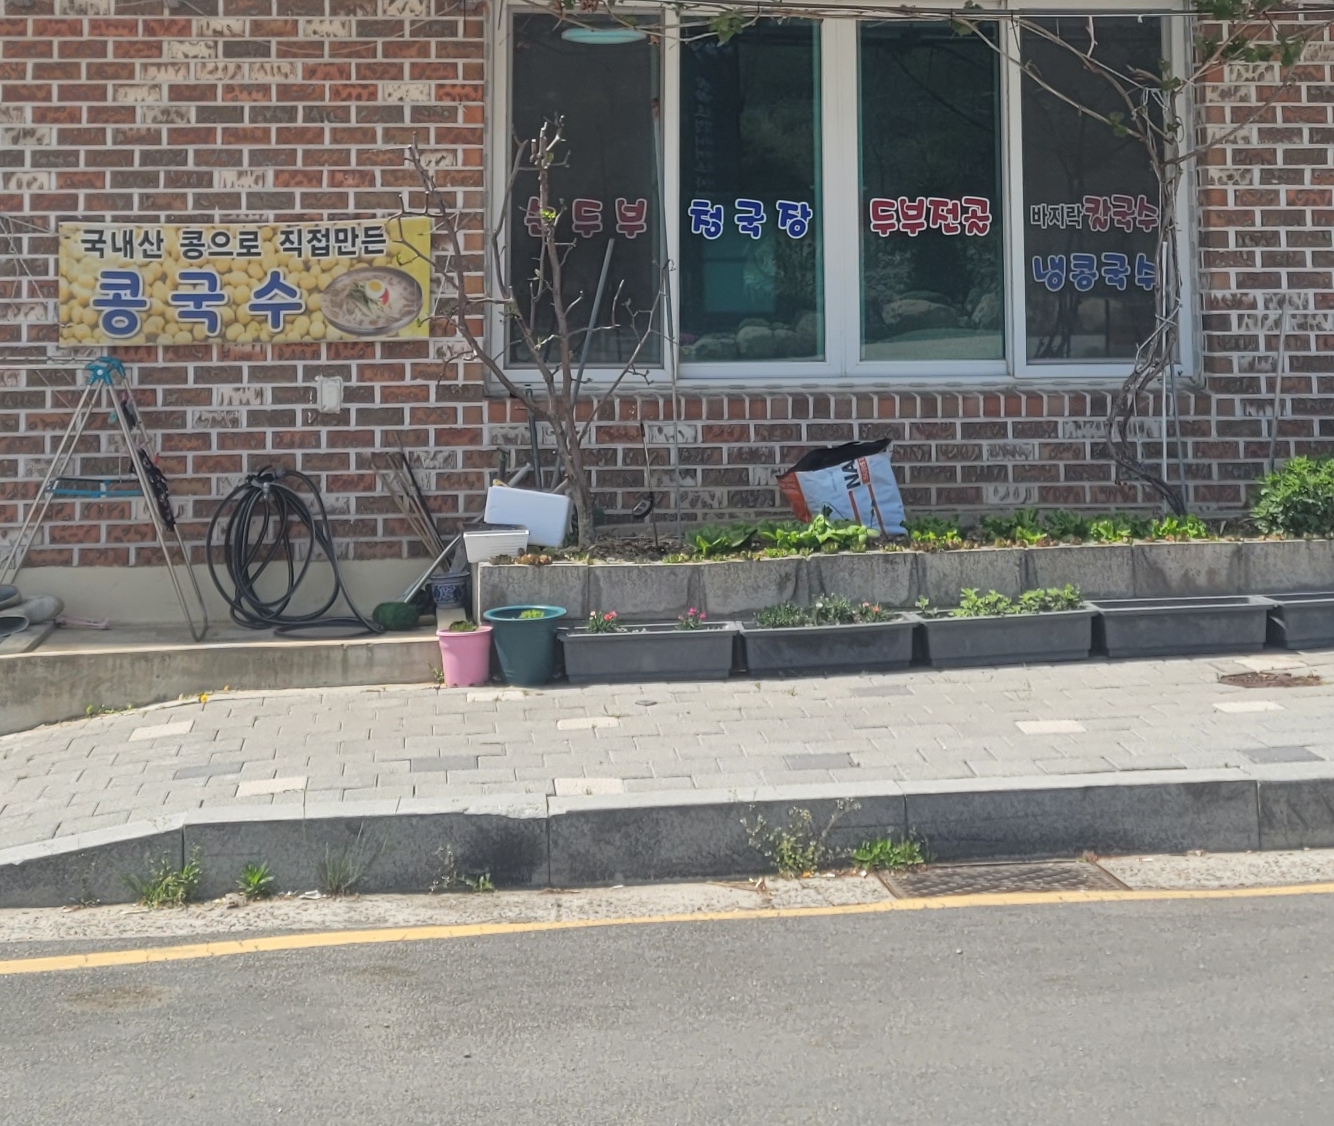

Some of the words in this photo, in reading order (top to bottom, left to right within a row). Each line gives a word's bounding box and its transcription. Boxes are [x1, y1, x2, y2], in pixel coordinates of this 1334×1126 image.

[688, 198, 813, 240] 청국장
[870, 196, 992, 238] 두부전골
[80, 228, 165, 261] 국내산
[179, 229, 263, 261] 콩으로
[278, 225, 388, 258] 직접만든
[90, 269, 306, 339] 콩국수
